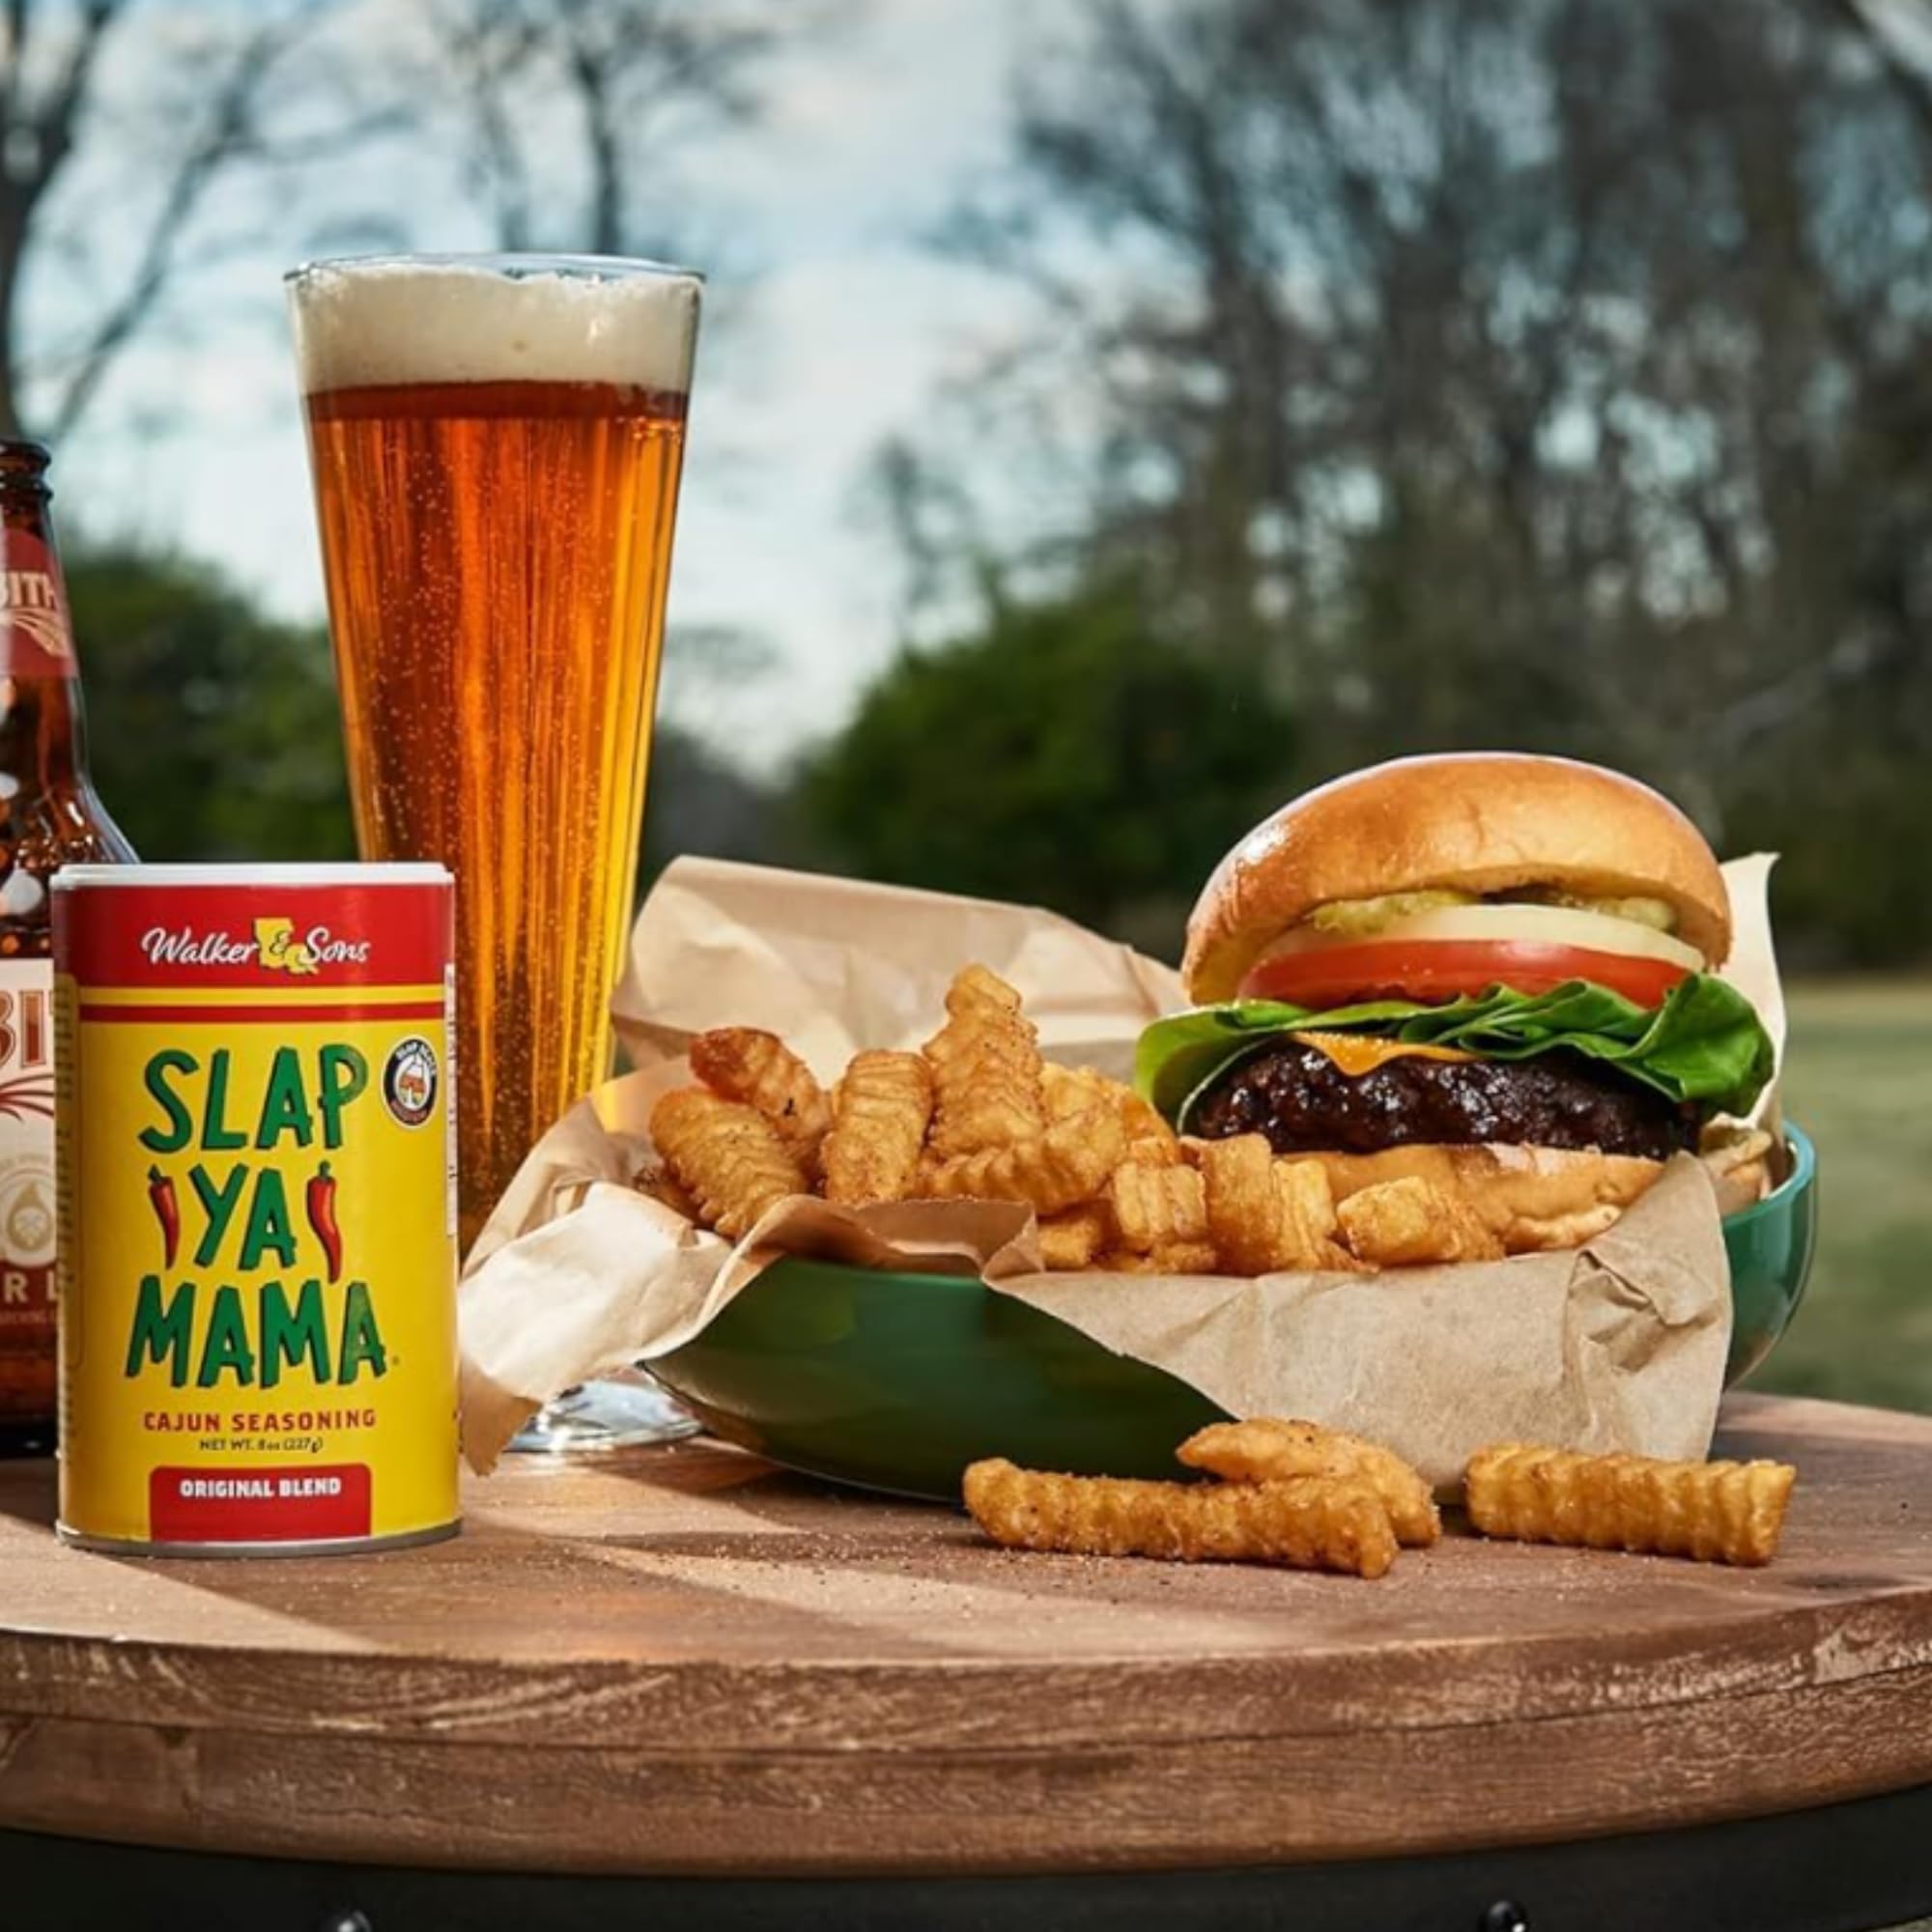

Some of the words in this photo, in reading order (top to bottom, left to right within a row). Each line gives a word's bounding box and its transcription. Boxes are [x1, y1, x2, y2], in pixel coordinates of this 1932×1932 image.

[141, 926, 259, 964] Walker
[302, 926, 370, 964] Sons
[138, 1043, 368, 1154] SLAP
[188, 1163, 298, 1271] YA
[125, 1275, 386, 1390] MAMA
[144, 1411, 220, 1432] CAJUN
[232, 1408, 377, 1432] SEASONING
[200, 1438, 226, 1451] NET
[180, 1480, 275, 1498] ORIGINAL
[278, 1477, 342, 1496] BLEND
